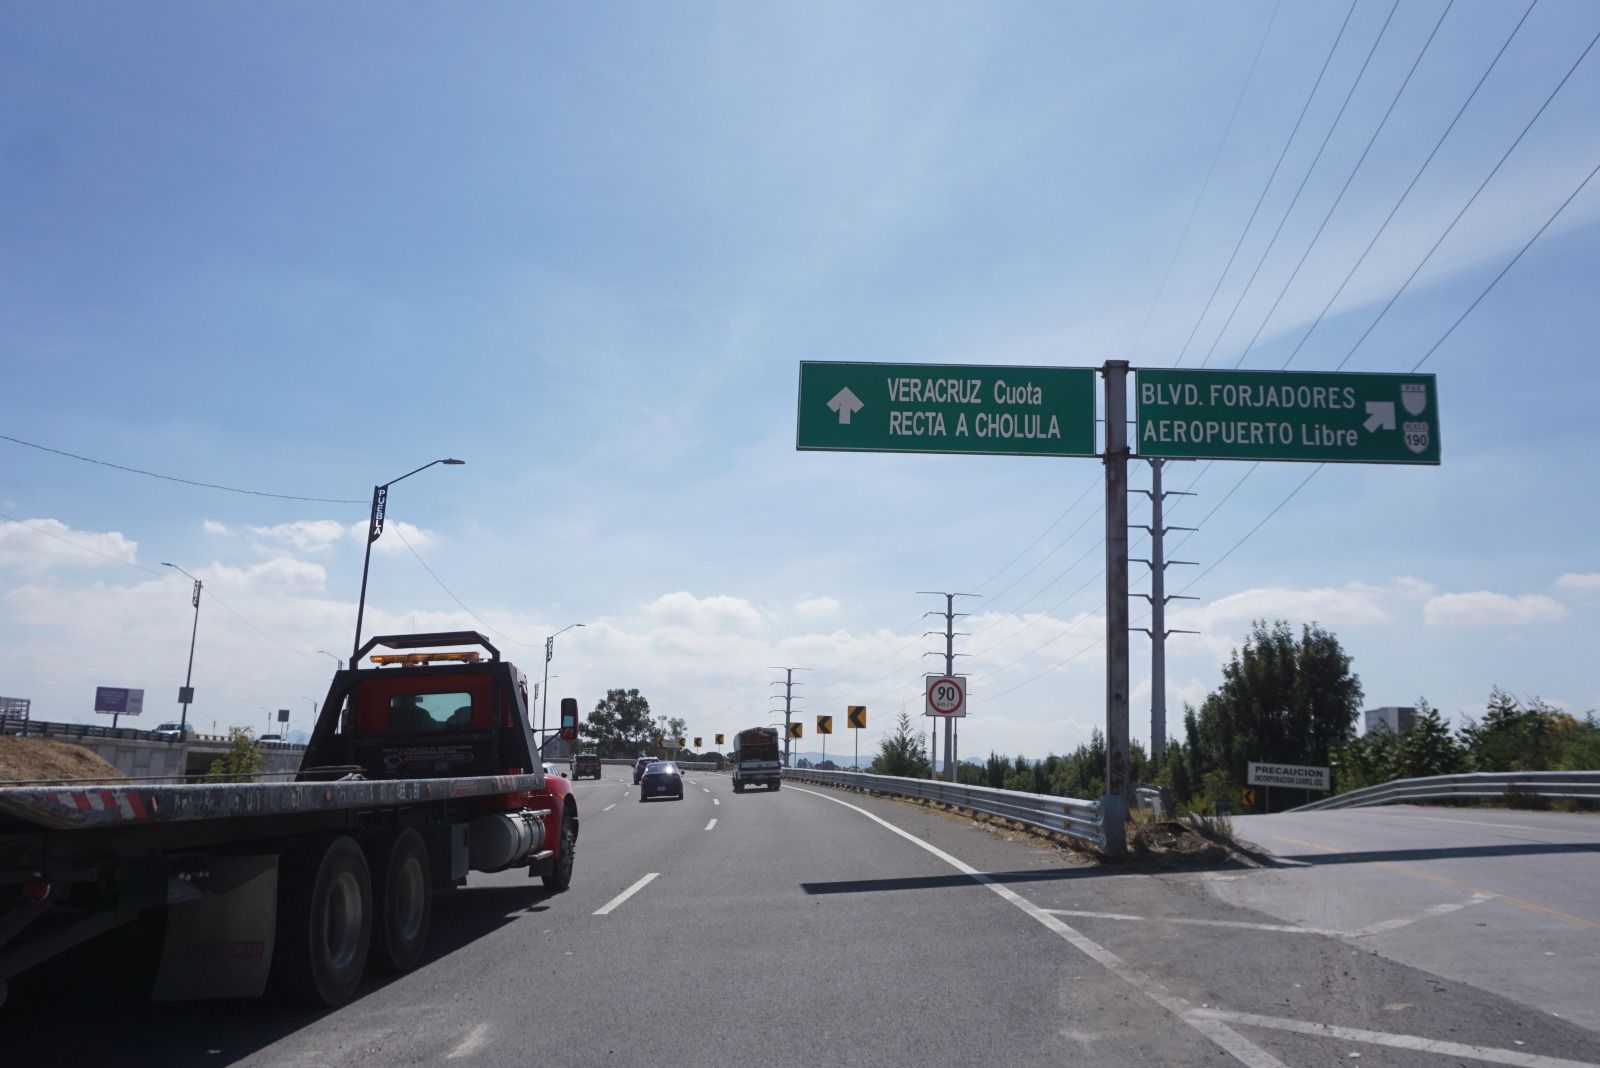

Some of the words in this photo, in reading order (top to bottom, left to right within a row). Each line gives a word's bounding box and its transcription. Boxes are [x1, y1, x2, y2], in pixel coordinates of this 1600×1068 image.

[888, 377, 981, 404] VERACRUZ
[994, 379, 1042, 405] Cuota
[1141, 383, 1203, 406] BLVD.
[1210, 384, 1355, 409] FORJADORES
[889, 411, 946, 437] RECTA
[955, 413, 969, 437] A
[975, 413, 1061, 439] CHOLULA
[1143, 420, 1293, 445] AEROPUERTO
[1302, 424, 1359, 446] Libre
[1406, 434, 1427, 446] 190
[373, 489, 386, 535] PUEBLA
[937, 686, 955, 701] 90
